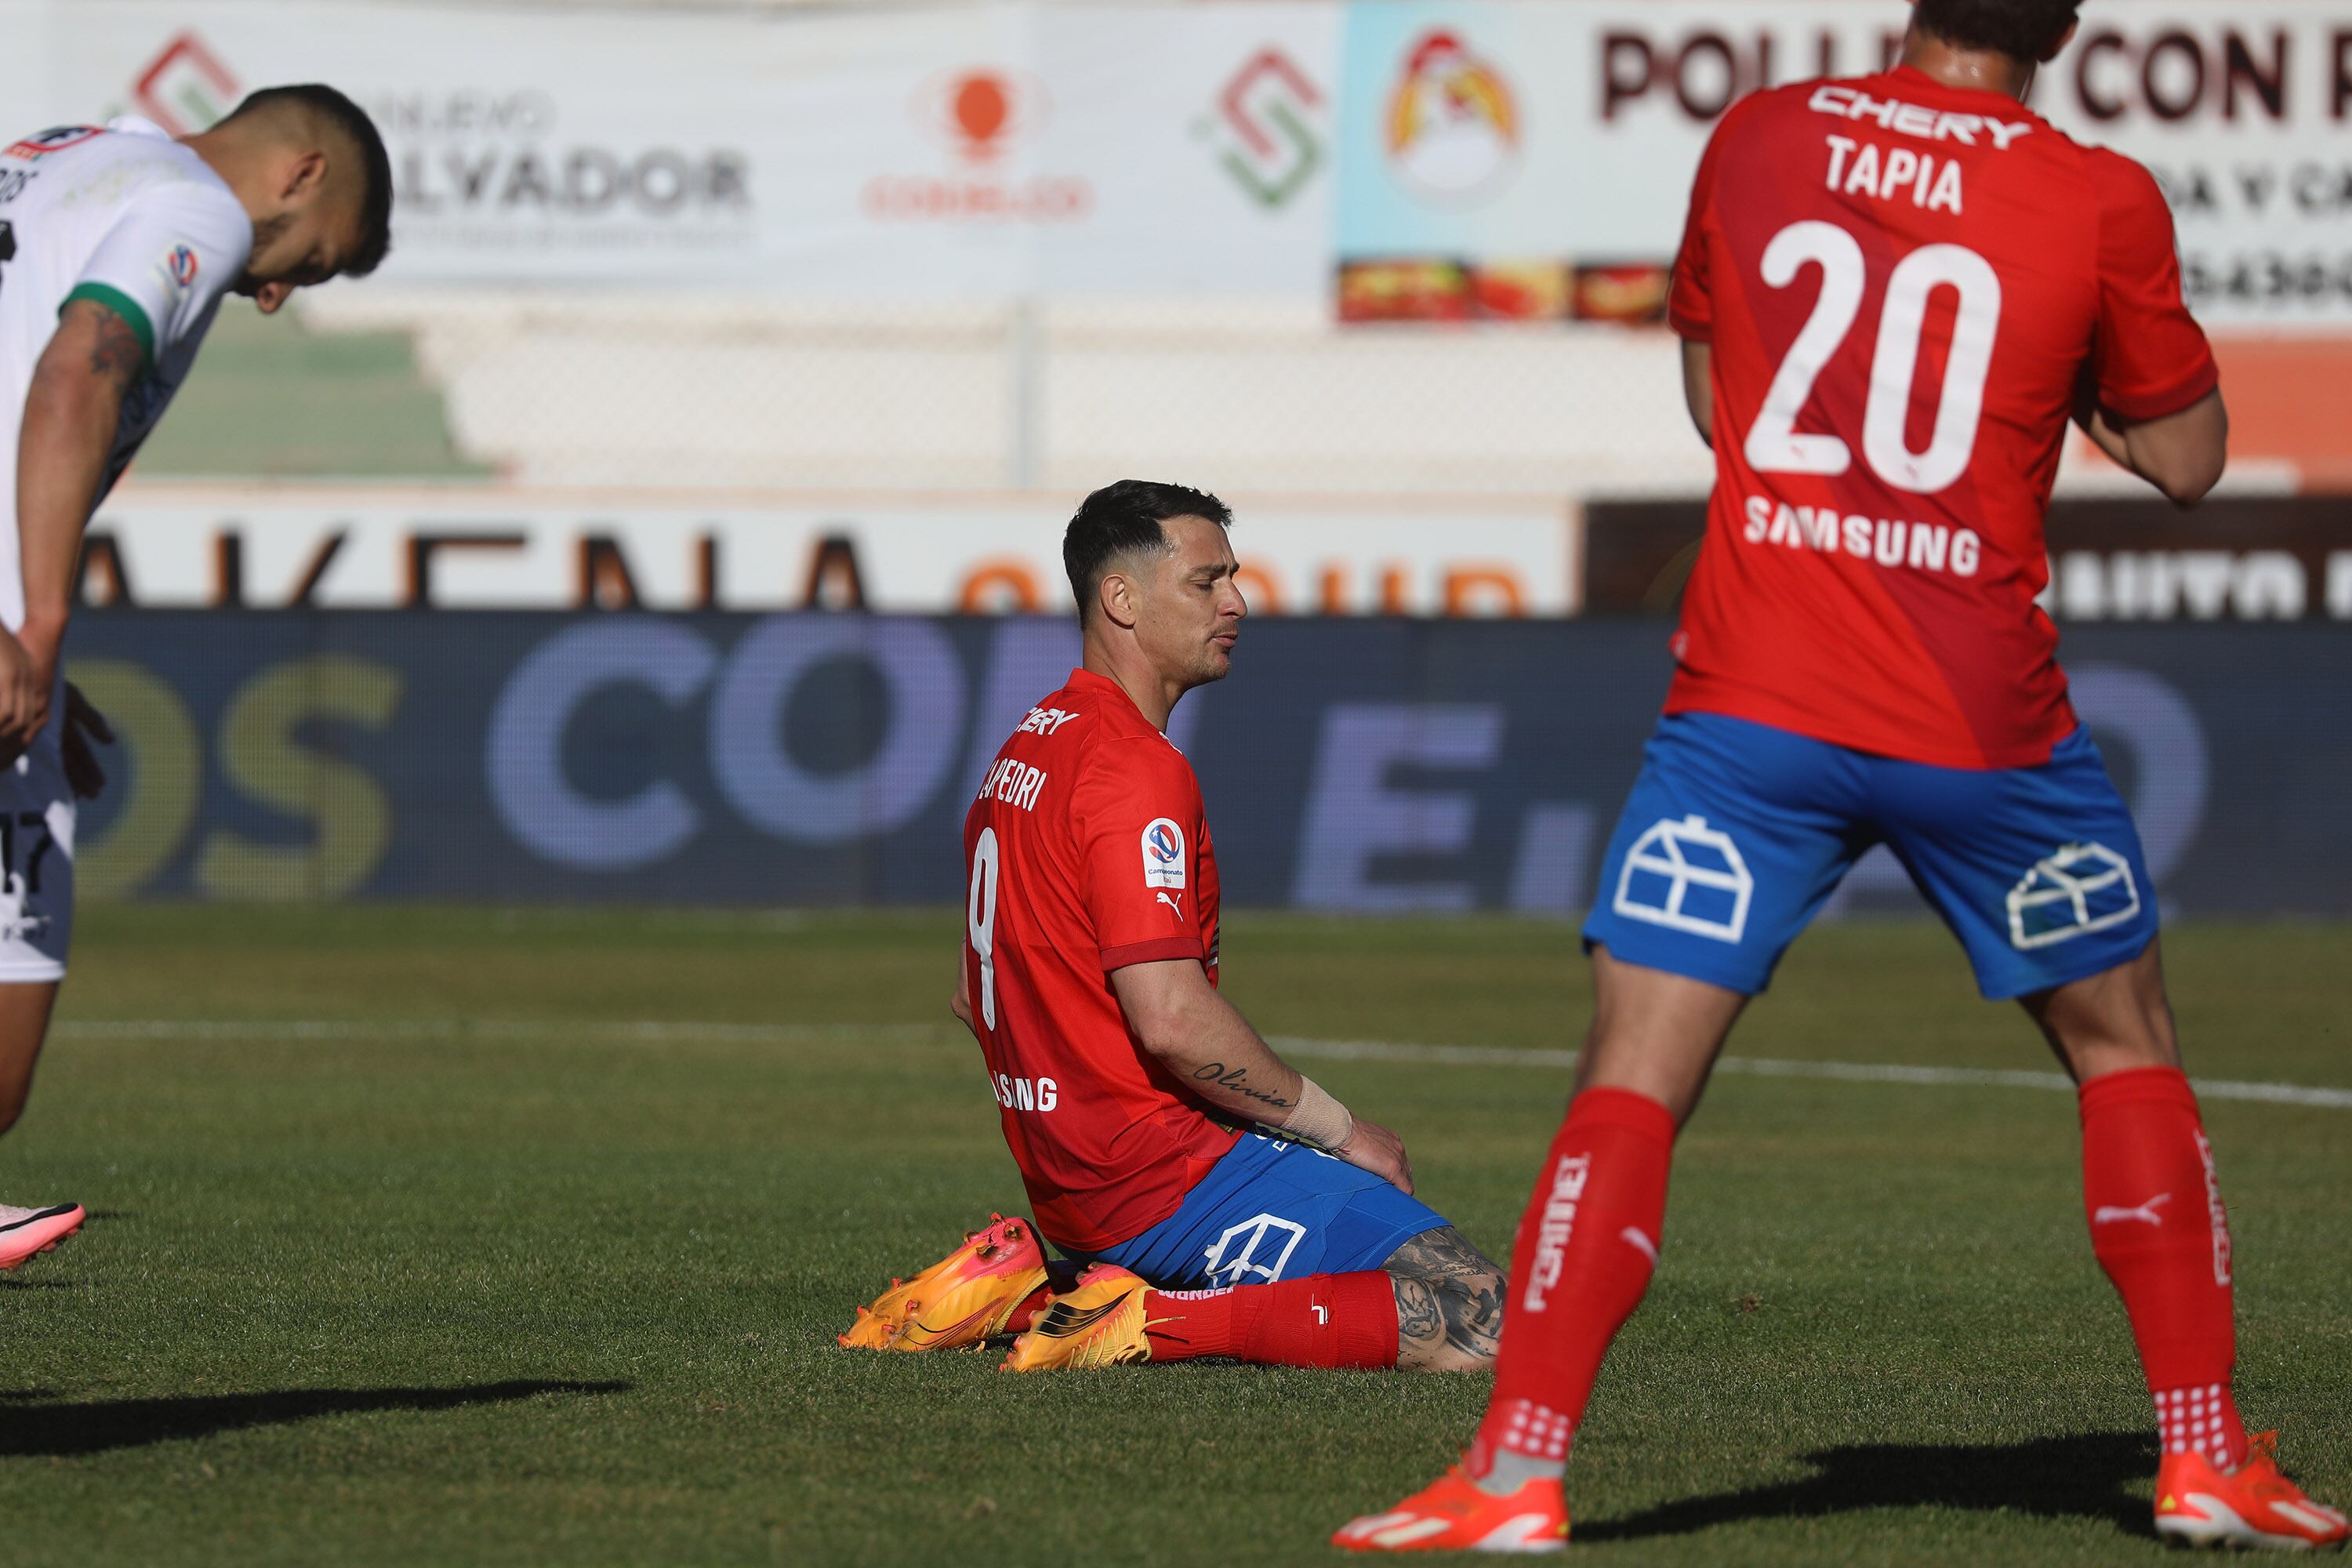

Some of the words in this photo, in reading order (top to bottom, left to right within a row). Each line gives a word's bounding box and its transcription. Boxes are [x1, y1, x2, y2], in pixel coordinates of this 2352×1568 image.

[2076, 30, 2288, 122] CON
[1809, 86, 2032, 150] CHERY
[1825, 133, 1962, 216] TAPIA
[1744, 220, 2002, 494] 20
[1744, 495, 1981, 577] SAMSUNG
[969, 826, 999, 1033] 9
[1193, 1062, 1294, 1109] Olivia
